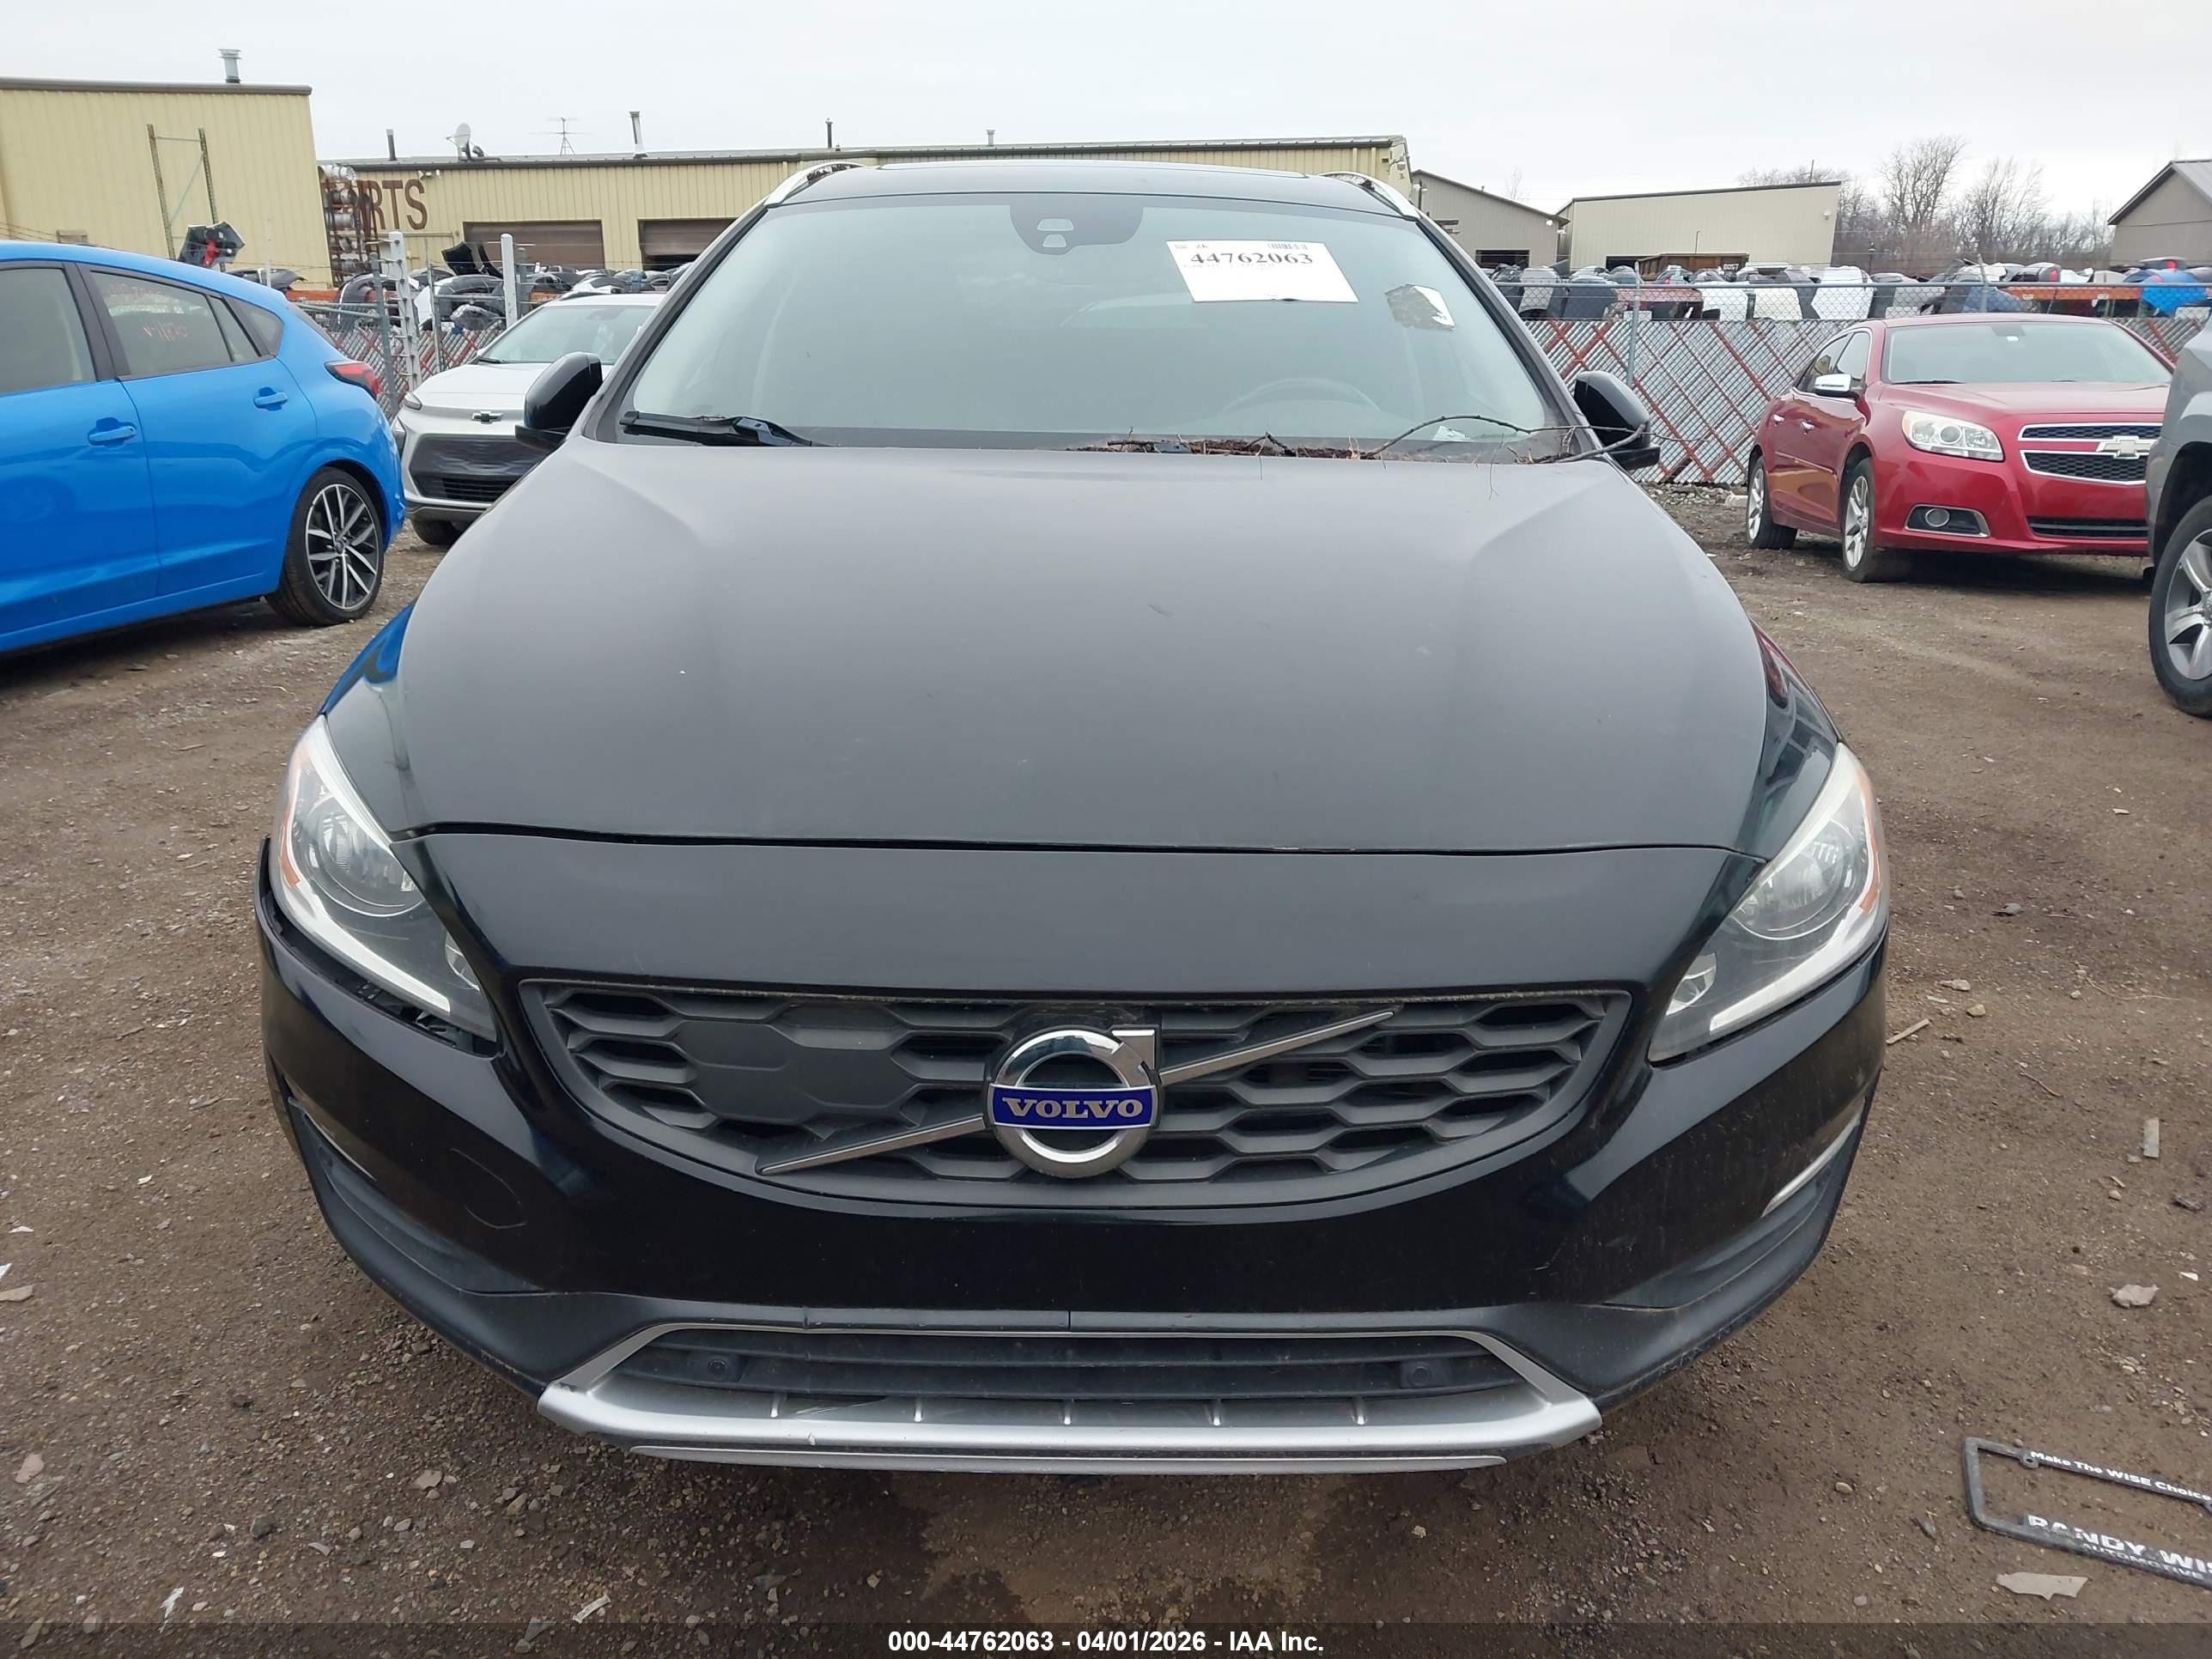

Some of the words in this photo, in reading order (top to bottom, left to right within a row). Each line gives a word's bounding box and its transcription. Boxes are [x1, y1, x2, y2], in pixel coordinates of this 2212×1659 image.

[1190, 252, 1313, 264] 44762063
[1002, 1097, 1144, 1119] VOLVO
[2030, 1451, 2071, 1466] Make
[2074, 1461, 2103, 1474] The
[2106, 1468, 2152, 1486] WISE
[2154, 1482, 2212, 1501] Choice
[2082, 1543, 2204, 1580] AUTOMOTIVE
